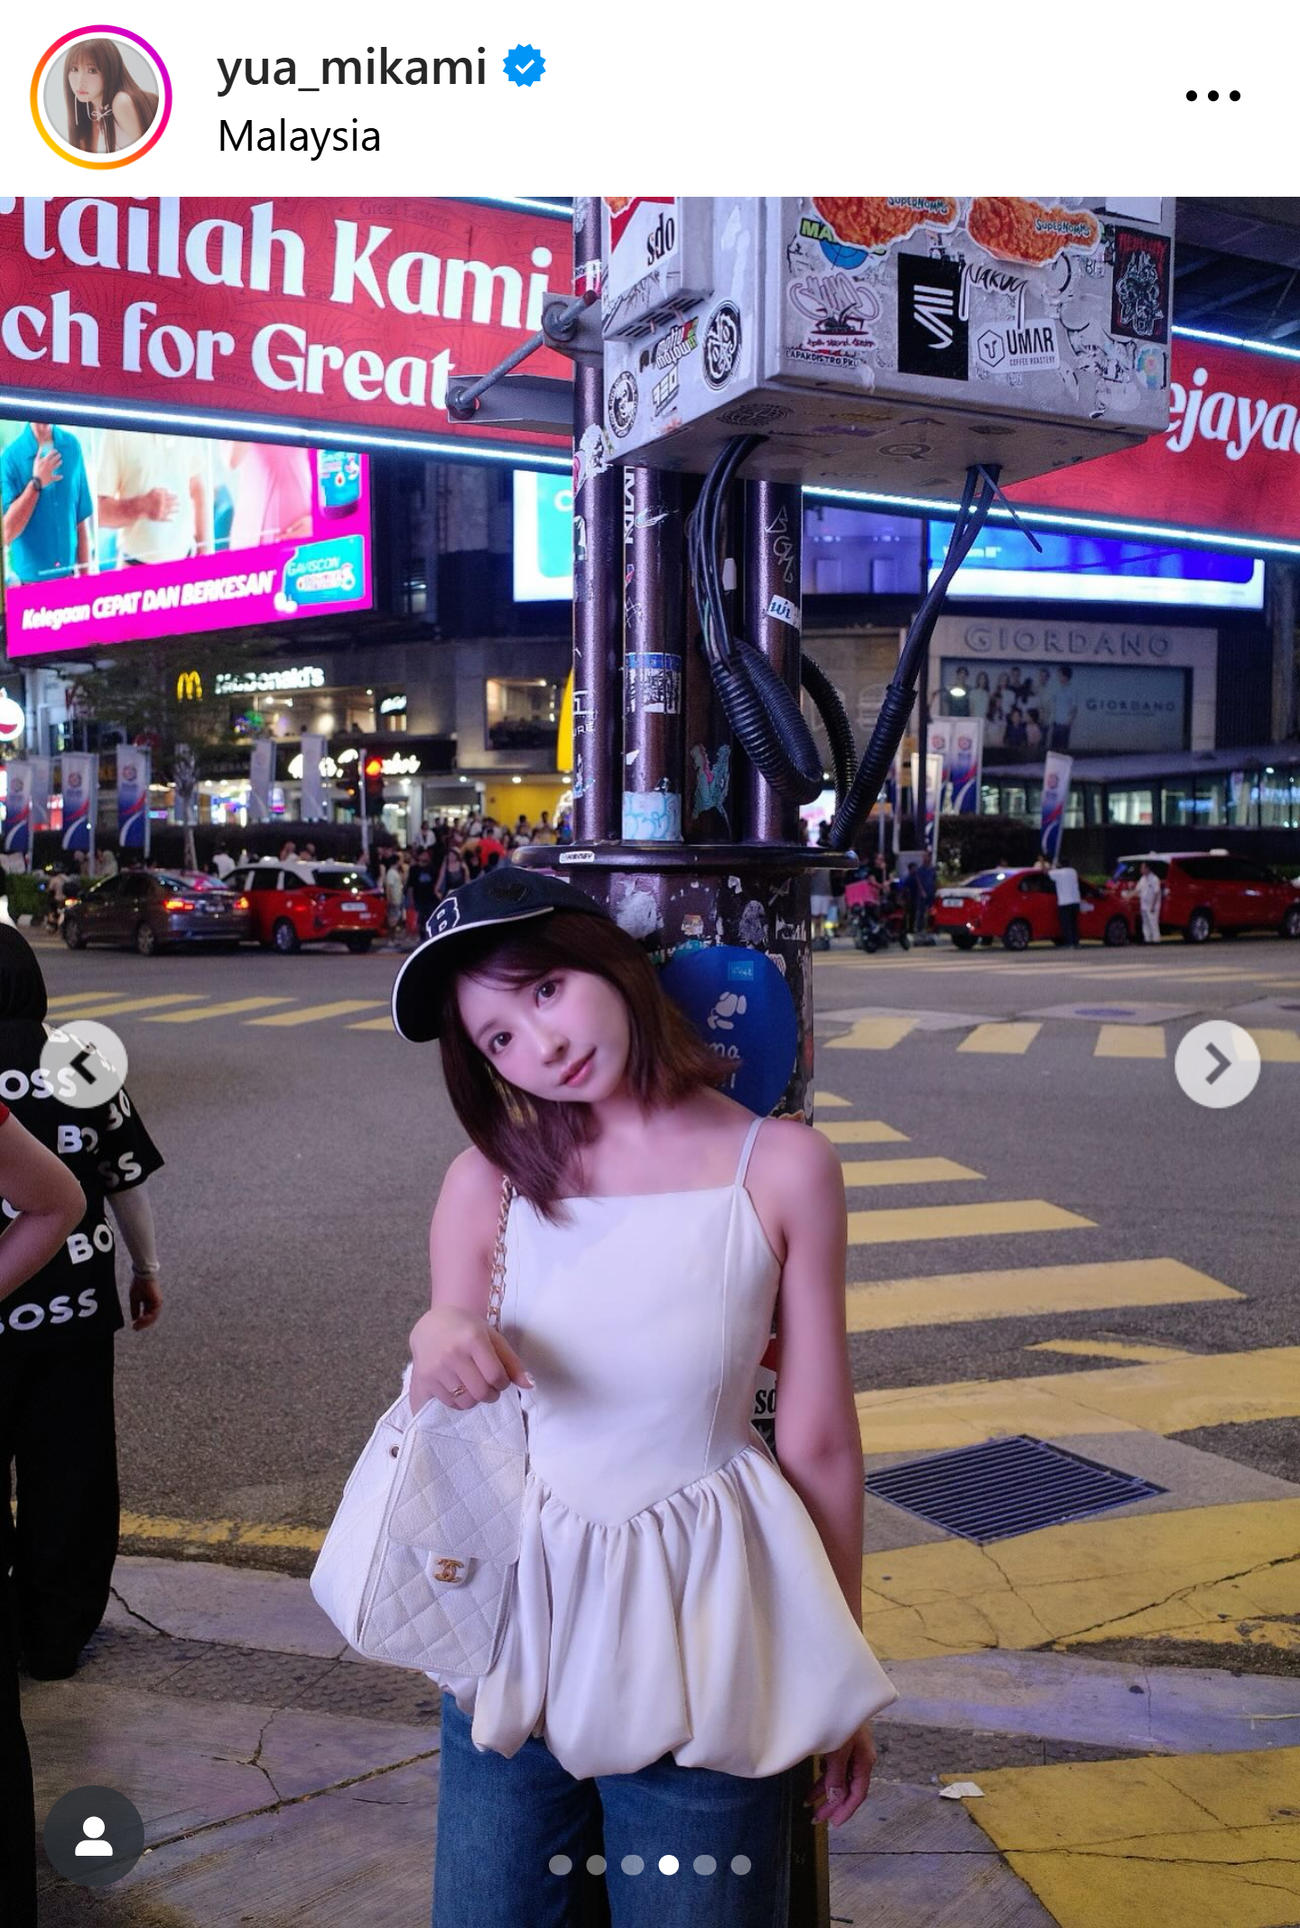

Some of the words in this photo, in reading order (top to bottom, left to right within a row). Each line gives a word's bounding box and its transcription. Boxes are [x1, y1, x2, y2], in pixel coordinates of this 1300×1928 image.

[0, 197, 304, 296] tailah
[333, 219, 553, 332] Kami
[1, 289, 101, 368] ch
[122, 301, 236, 382] for
[251, 323, 455, 411] Great
[1006, 327, 1055, 355] UMAR
[1009, 358, 1029, 367] COFFEE
[1165, 367, 1300, 461] ejaya
[22, 604, 91, 631] Kelegaan
[91, 590, 143, 620] CEPAT
[141, 585, 182, 612] DAN
[181, 571, 275, 607] BERKESAN
[964, 624, 1171, 657] GIORDANO
[1086, 700, 1176, 712] GIORDANO
[0, 1288, 99, 1335] OSS
